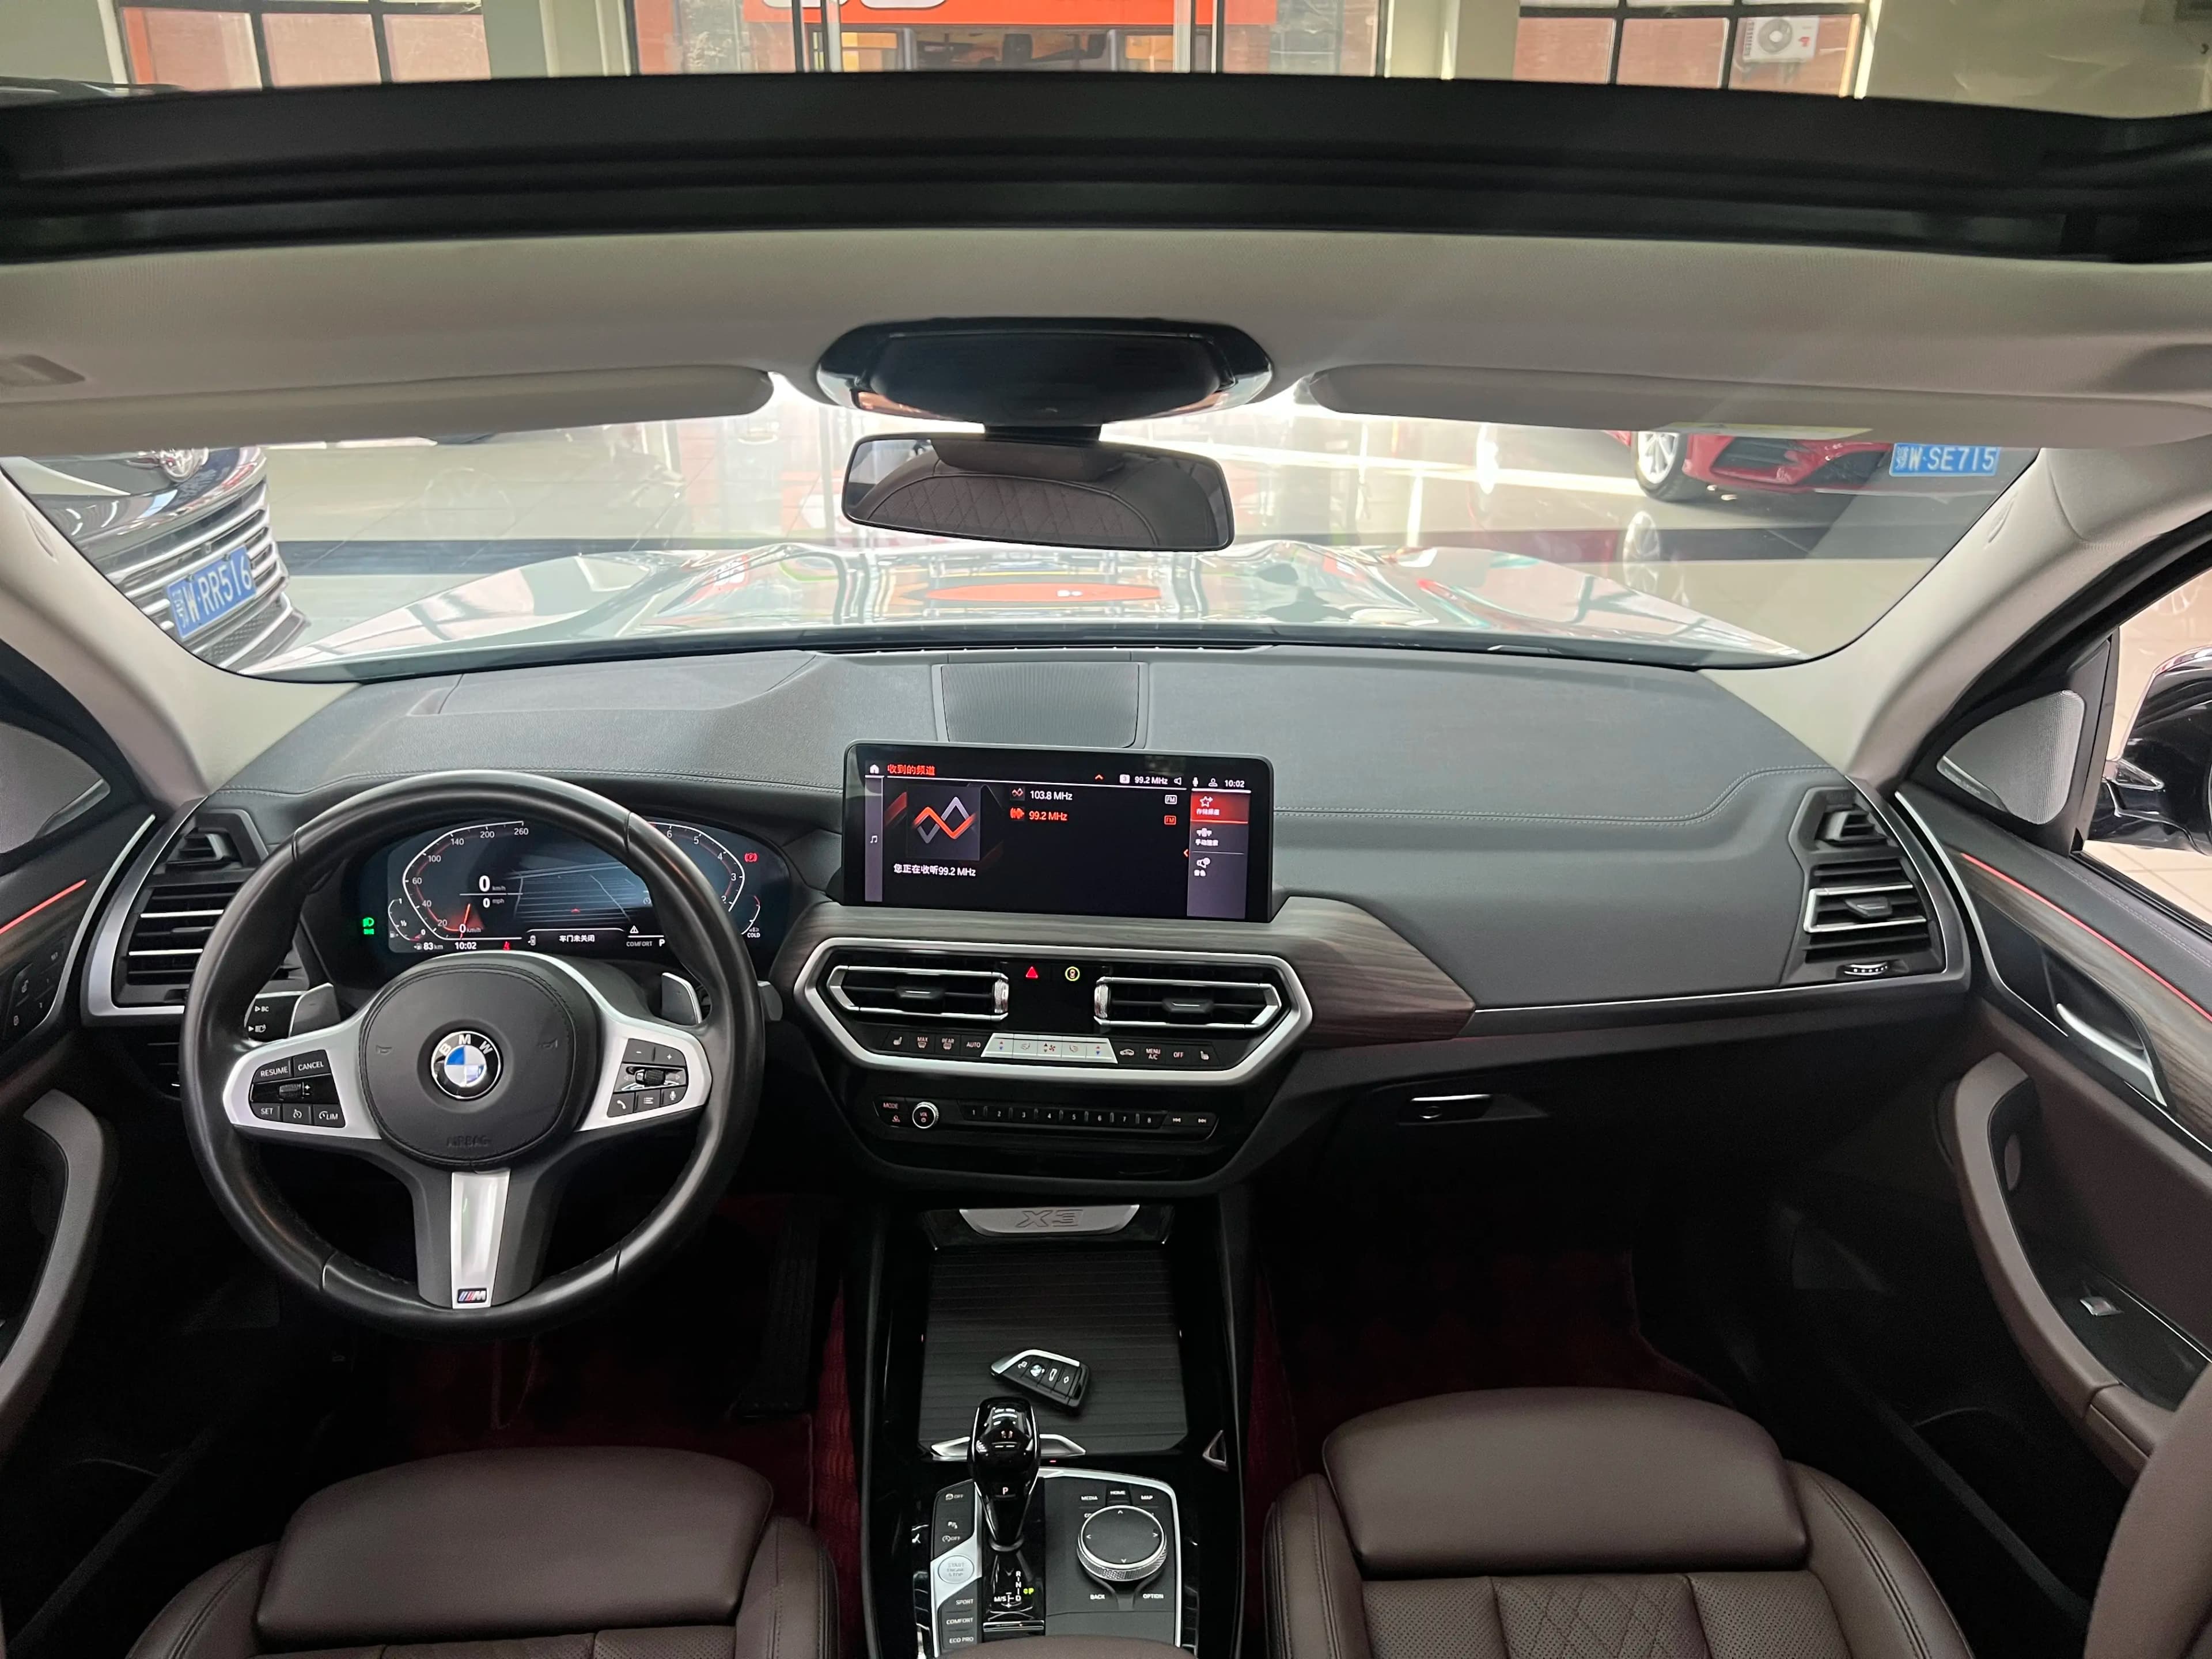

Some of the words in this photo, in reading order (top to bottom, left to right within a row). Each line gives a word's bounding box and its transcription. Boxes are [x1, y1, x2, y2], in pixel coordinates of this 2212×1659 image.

[887, 764, 935, 776] 收到的频道
[1134, 776, 1150, 784] 99.2
[1152, 777, 1168, 785] MHz
[1224, 779, 1245, 787] 10:02
[1030, 790, 1052, 800] 103.8
[1054, 791, 1073, 801] MHz
[1166, 796, 1176, 804] FM
[1029, 811, 1047, 820] 99.2
[1048, 812, 1068, 821] MHz
[480, 831, 495, 839] 200
[666, 830, 672, 839] 6
[694, 836, 699, 844] 5
[427, 855, 442, 863] 100
[717, 852, 723, 861] 4
[893, 863, 956, 876] 您正在收听99.2
[957, 868, 976, 877] MHz
[730, 873, 737, 881] 3
[479, 875, 491, 892] 0
[482, 897, 490, 908] 0
[459, 924, 467, 933] 0
[423, 942, 434, 950] 83
[454, 942, 477, 950] 10:02
[658, 939, 665, 947] P
[438, 1033, 494, 1056] BMW
[298, 1060, 324, 1071] CANCEL
[260, 1066, 289, 1077] RESUME
[1014, 1209, 1084, 1228] X3
[1002, 1487, 1009, 1495] P
[946, 1617, 974, 1625] COMFORT
